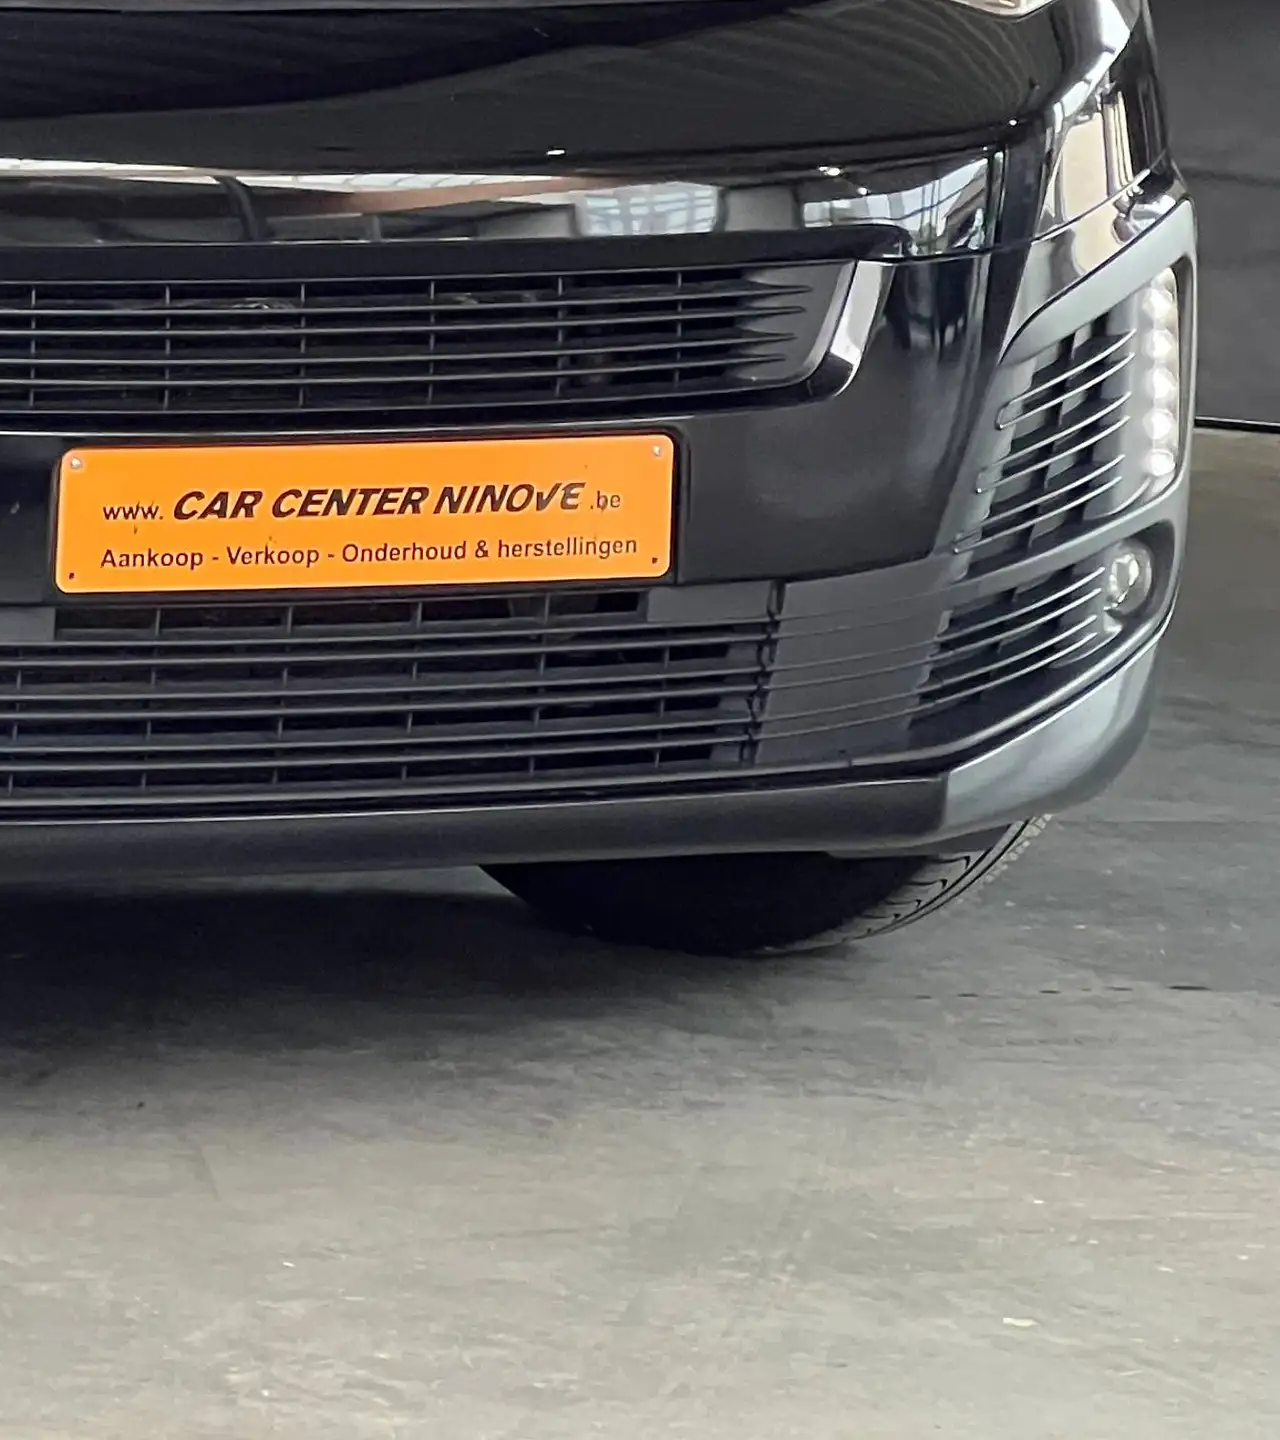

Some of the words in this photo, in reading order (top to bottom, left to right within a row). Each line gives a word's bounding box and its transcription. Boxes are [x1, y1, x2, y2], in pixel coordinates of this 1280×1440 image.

[101, 503, 165, 521] www.
[173, 490, 264, 521] CAR
[271, 486, 430, 519] CENTER
[432, 482, 586, 516] NINOVE
[589, 490, 622, 511] .be
[100, 547, 204, 571] Aankoop
[226, 544, 320, 569] Verkoop
[342, 540, 467, 564] Onderhoud
[474, 539, 490, 559] &
[497, 536, 638, 560] herstellingen
